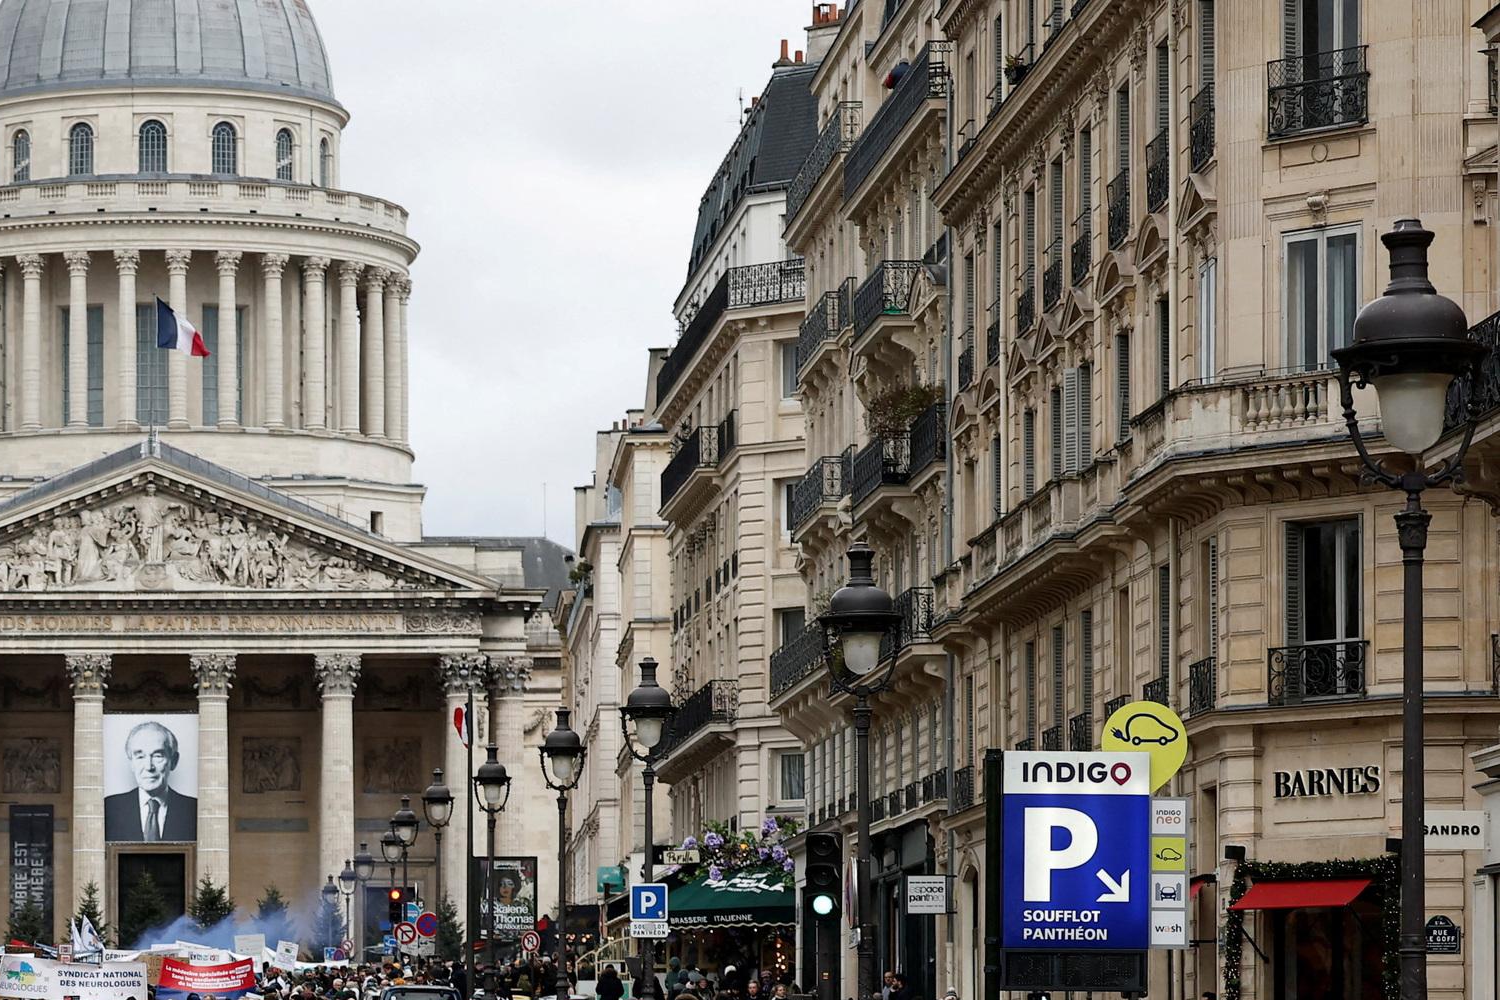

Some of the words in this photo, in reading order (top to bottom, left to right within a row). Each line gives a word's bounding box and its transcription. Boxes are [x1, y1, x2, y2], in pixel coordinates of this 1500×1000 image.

[31, 616, 113, 631] HOMMES
[150, 616, 221, 631] PATRIE
[228, 616, 397, 631] RECONNAISSANTE
[1022, 762, 1132, 786] INDIGO
[1273, 766, 1380, 798] BARNES
[1156, 816, 1182, 825] neo
[1422, 825, 1481, 836] SANDRO
[14, 841, 28, 866] EST
[1024, 807, 1098, 902] P
[481, 901, 529, 914] Mkalene
[640, 892, 657, 914] P
[494, 914, 534, 923] Thomas
[670, 915, 708, 924] BRASSERIE
[713, 914, 753, 922] ITALIENNE
[1023, 909, 1101, 922] SOUFFLOT
[1023, 926, 1108, 941] PANTHÉON
[1155, 923, 1182, 933] wash
[58, 970, 100, 979] SYNDICAT
[102, 970, 144, 979] NATIONAL
[79, 980, 142, 988] NEUROLOGUES
